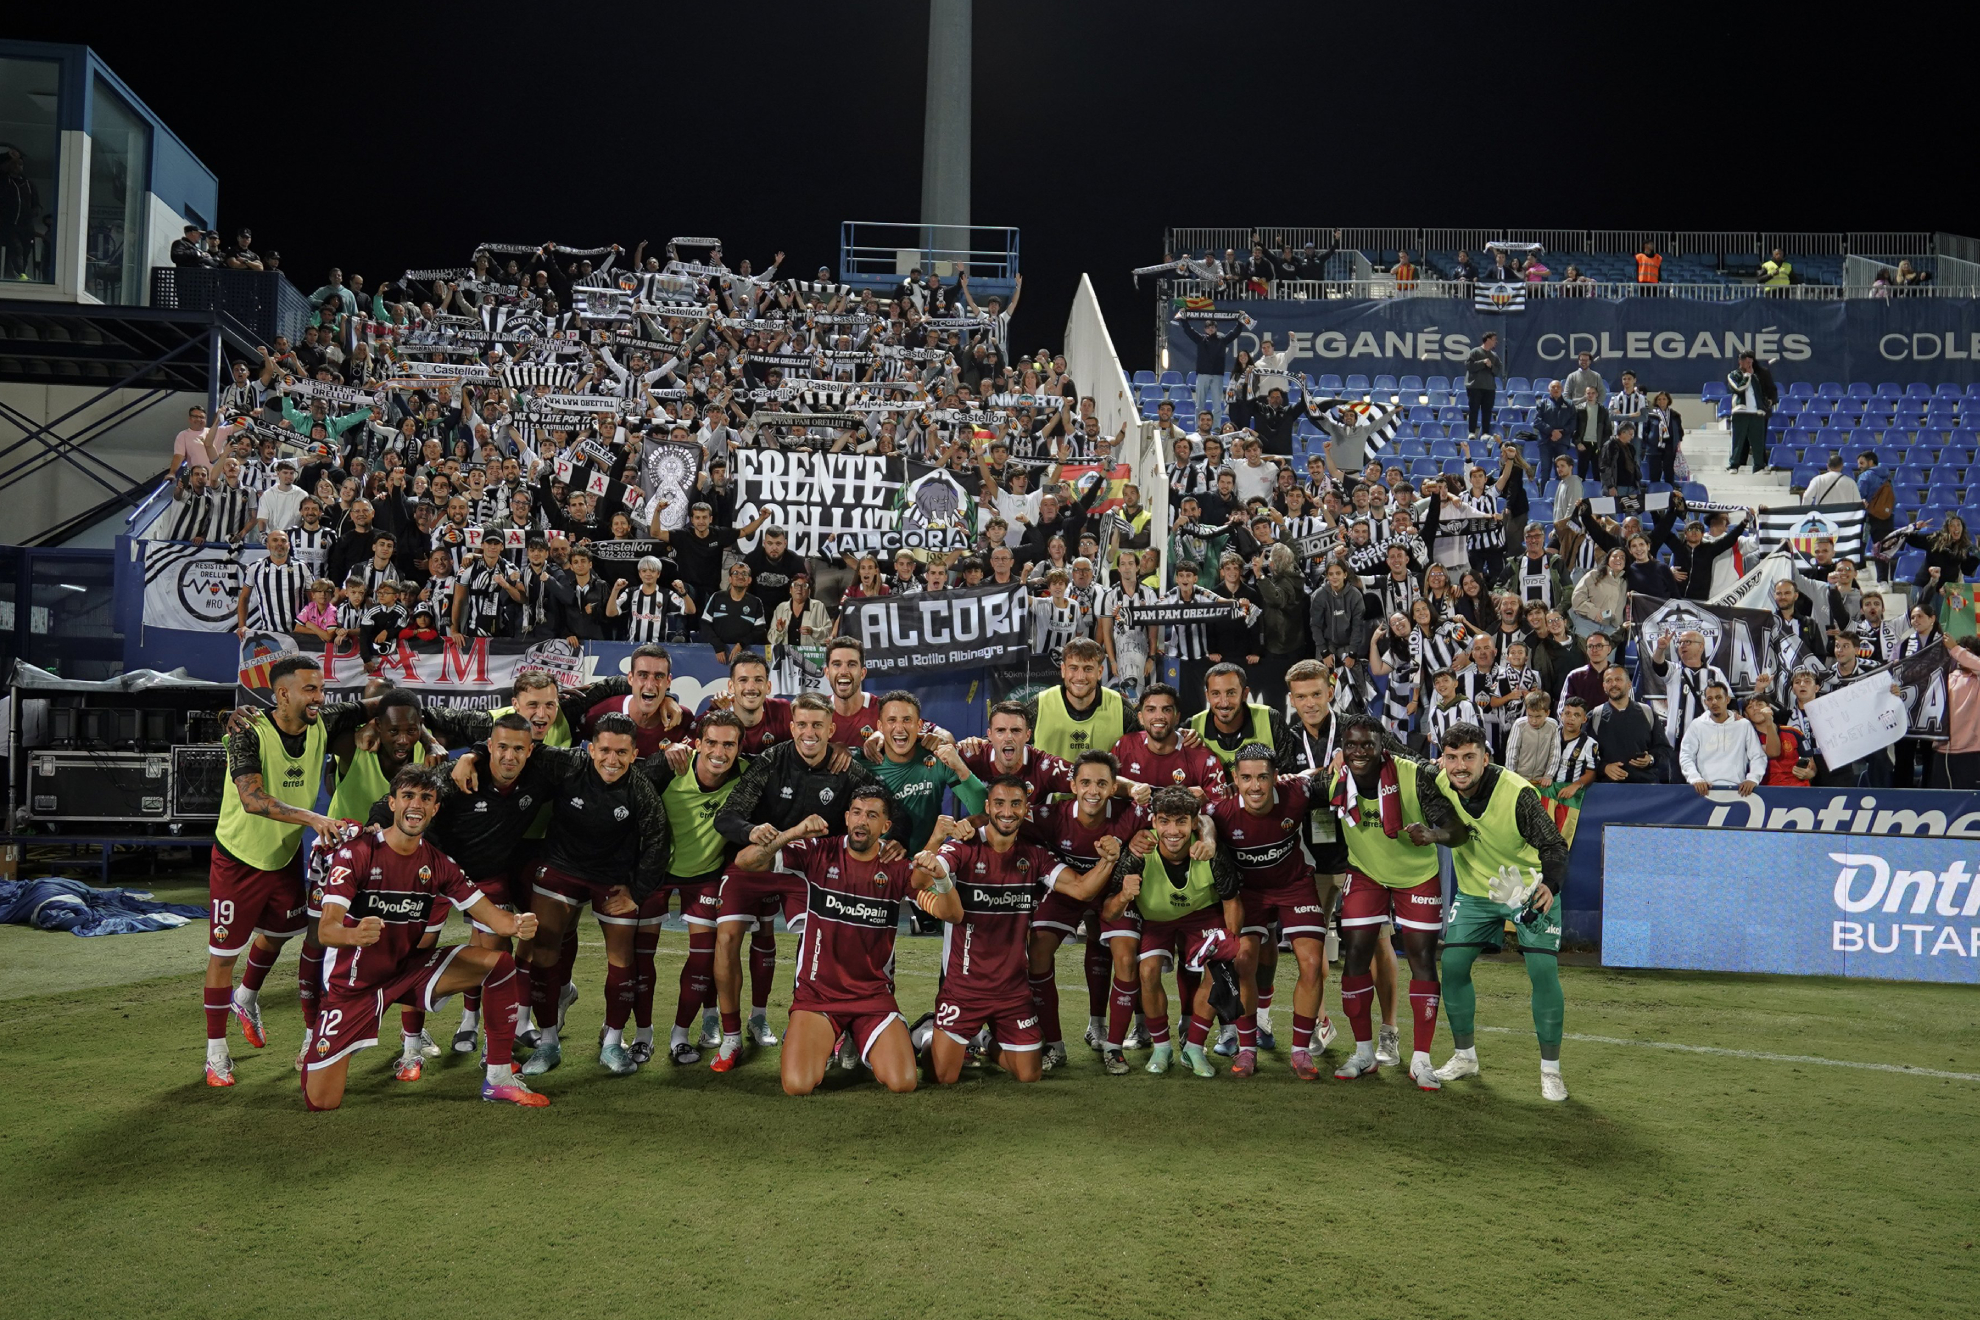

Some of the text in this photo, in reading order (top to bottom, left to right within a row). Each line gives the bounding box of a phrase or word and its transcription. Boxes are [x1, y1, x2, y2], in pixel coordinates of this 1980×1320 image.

[643, 305, 703, 318] CDCastellón
[724, 318, 785, 330] CDCastellón
[616, 336, 679, 352] PAM PAM ORELLUT
[750, 355, 810, 366] PAM PAM ORELLUT
[417, 363, 485, 377] CDCastellón
[302, 378, 365, 396] RESISTENCIA
[312, 387, 355, 401] ORELLUT
[514, 411, 526, 421] MI
[541, 413, 562, 423] LATE
[562, 414, 580, 424] POR
[812, 418, 845, 428] ORELLUT
[933, 411, 1006, 425] CDCastellón
[257, 419, 311, 444] CDCastellón
[557, 462, 568, 477] P
[590, 476, 604, 493] A
[735, 448, 887, 507] FRENTE
[469, 530, 481, 545] P
[507, 530, 523, 545] A
[839, 529, 968, 552] ALCORA
[597, 550, 635, 559] 1922-2022
[1133, 606, 1231, 621] PAM PAM ORELLUT
[865, 657, 895, 671] enya
[898, 653, 908, 667] el
[949, 645, 1004, 663] Albinegre
[448, 694, 502, 711] MADRID
[282, 778, 304, 789] errea
[974, 889, 1031, 907] DoyouSpain
[213, 898, 235, 925] 19
[826, 895, 888, 918] DoyouSpain
[319, 1009, 343, 1036] 12
[937, 1002, 960, 1027] 22
